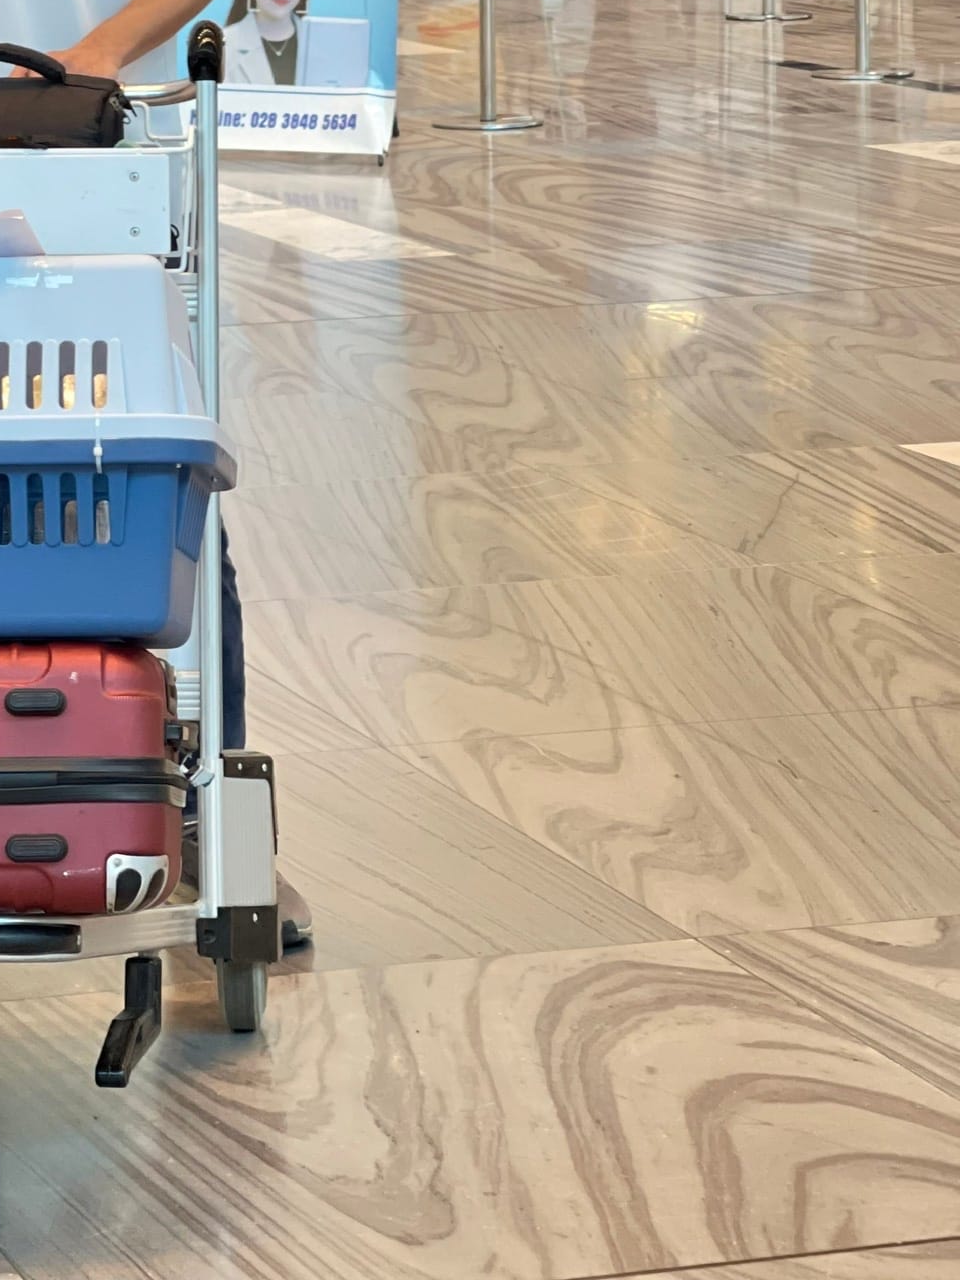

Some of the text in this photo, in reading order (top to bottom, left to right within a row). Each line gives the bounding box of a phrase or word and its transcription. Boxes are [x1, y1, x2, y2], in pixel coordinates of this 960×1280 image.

[250, 112, 278, 128] 028
[281, 113, 318, 130] 3848
[322, 113, 357, 130] 5634
